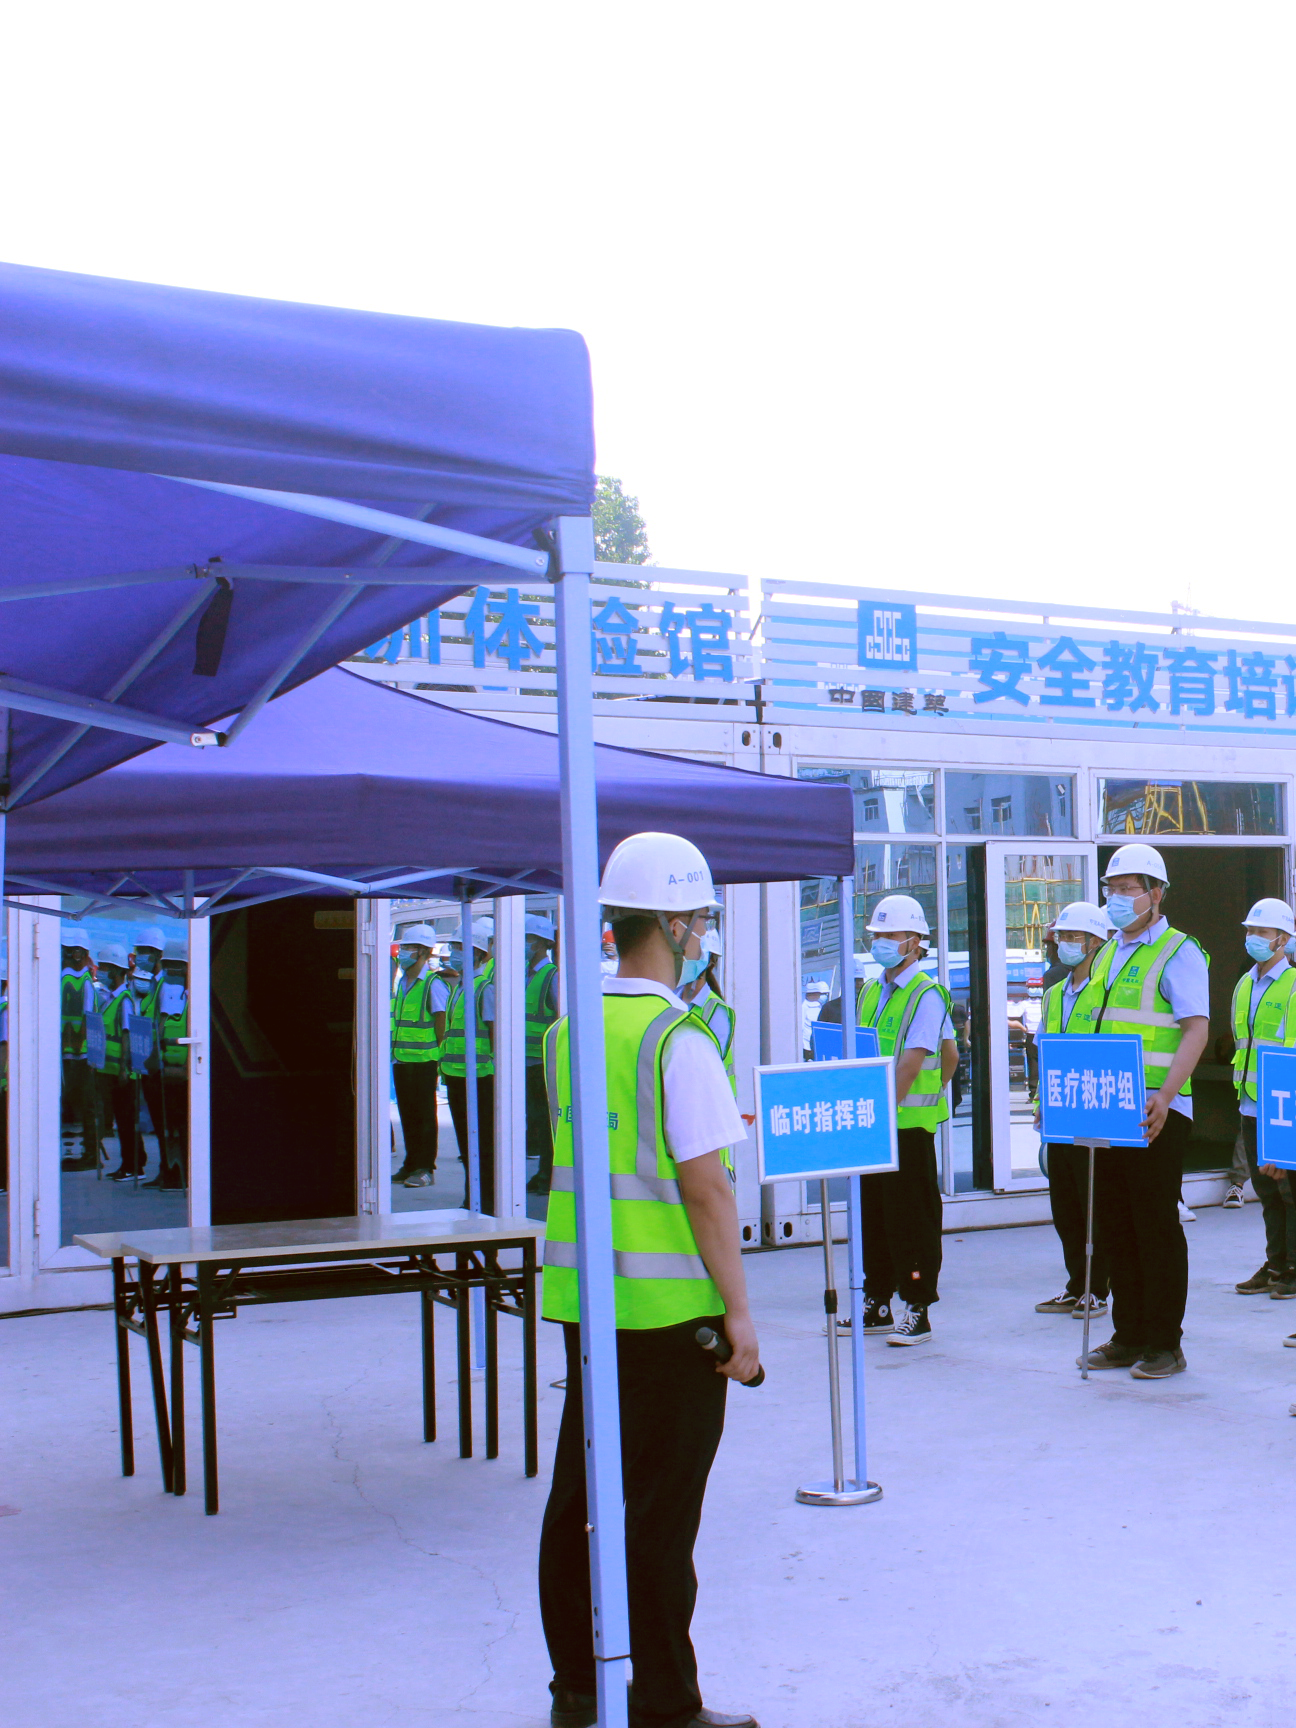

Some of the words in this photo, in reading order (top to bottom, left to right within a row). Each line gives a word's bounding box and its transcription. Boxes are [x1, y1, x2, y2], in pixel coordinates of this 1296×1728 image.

[668, 870, 704, 886] A-001
[1046, 1068, 1136, 1110] 医疗救护组
[769, 1097, 876, 1137] 临时指挥部
